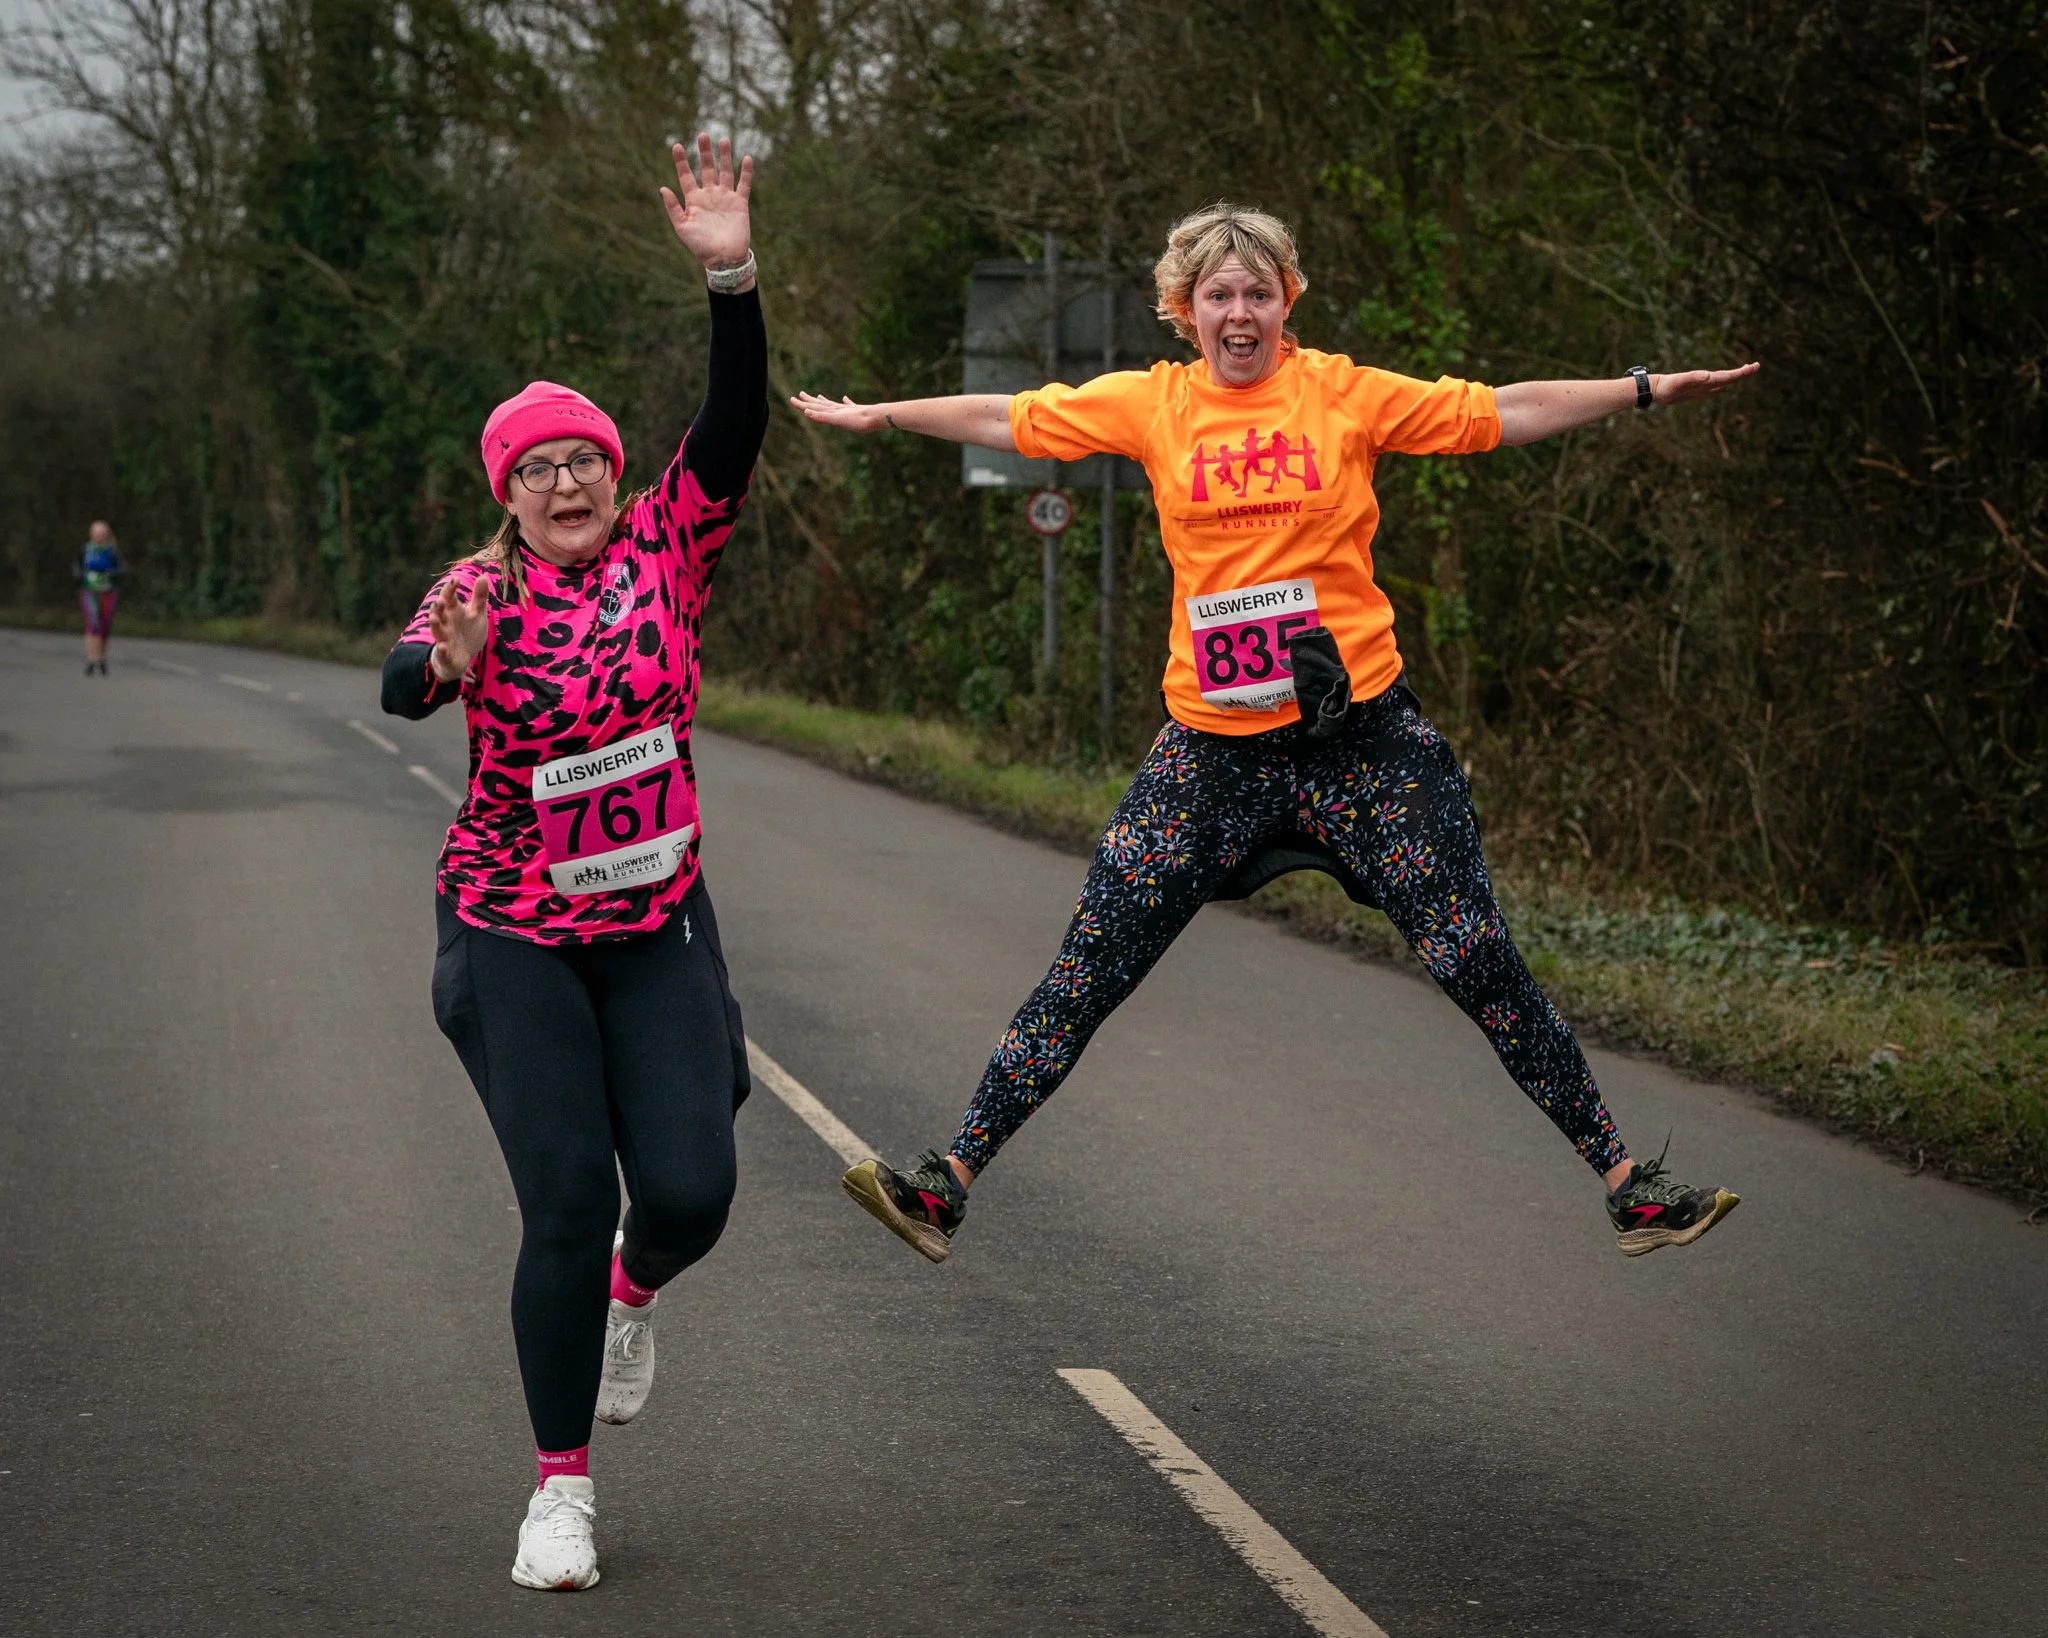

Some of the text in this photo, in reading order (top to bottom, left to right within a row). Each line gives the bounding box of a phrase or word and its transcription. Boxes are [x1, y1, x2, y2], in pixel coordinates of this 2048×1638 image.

[1217, 500, 1303, 519] LLISWERRY
[1222, 518, 1300, 530] RUNNERS
[1197, 587, 1304, 618] LLISWERRY 8
[1250, 689, 1292, 704] LLISWERRY
[545, 738, 664, 787] LLISWERRY 8
[548, 768, 672, 855] 767
[612, 851, 660, 871] LLISWERRY
[614, 861, 663, 878] RUNNERS
